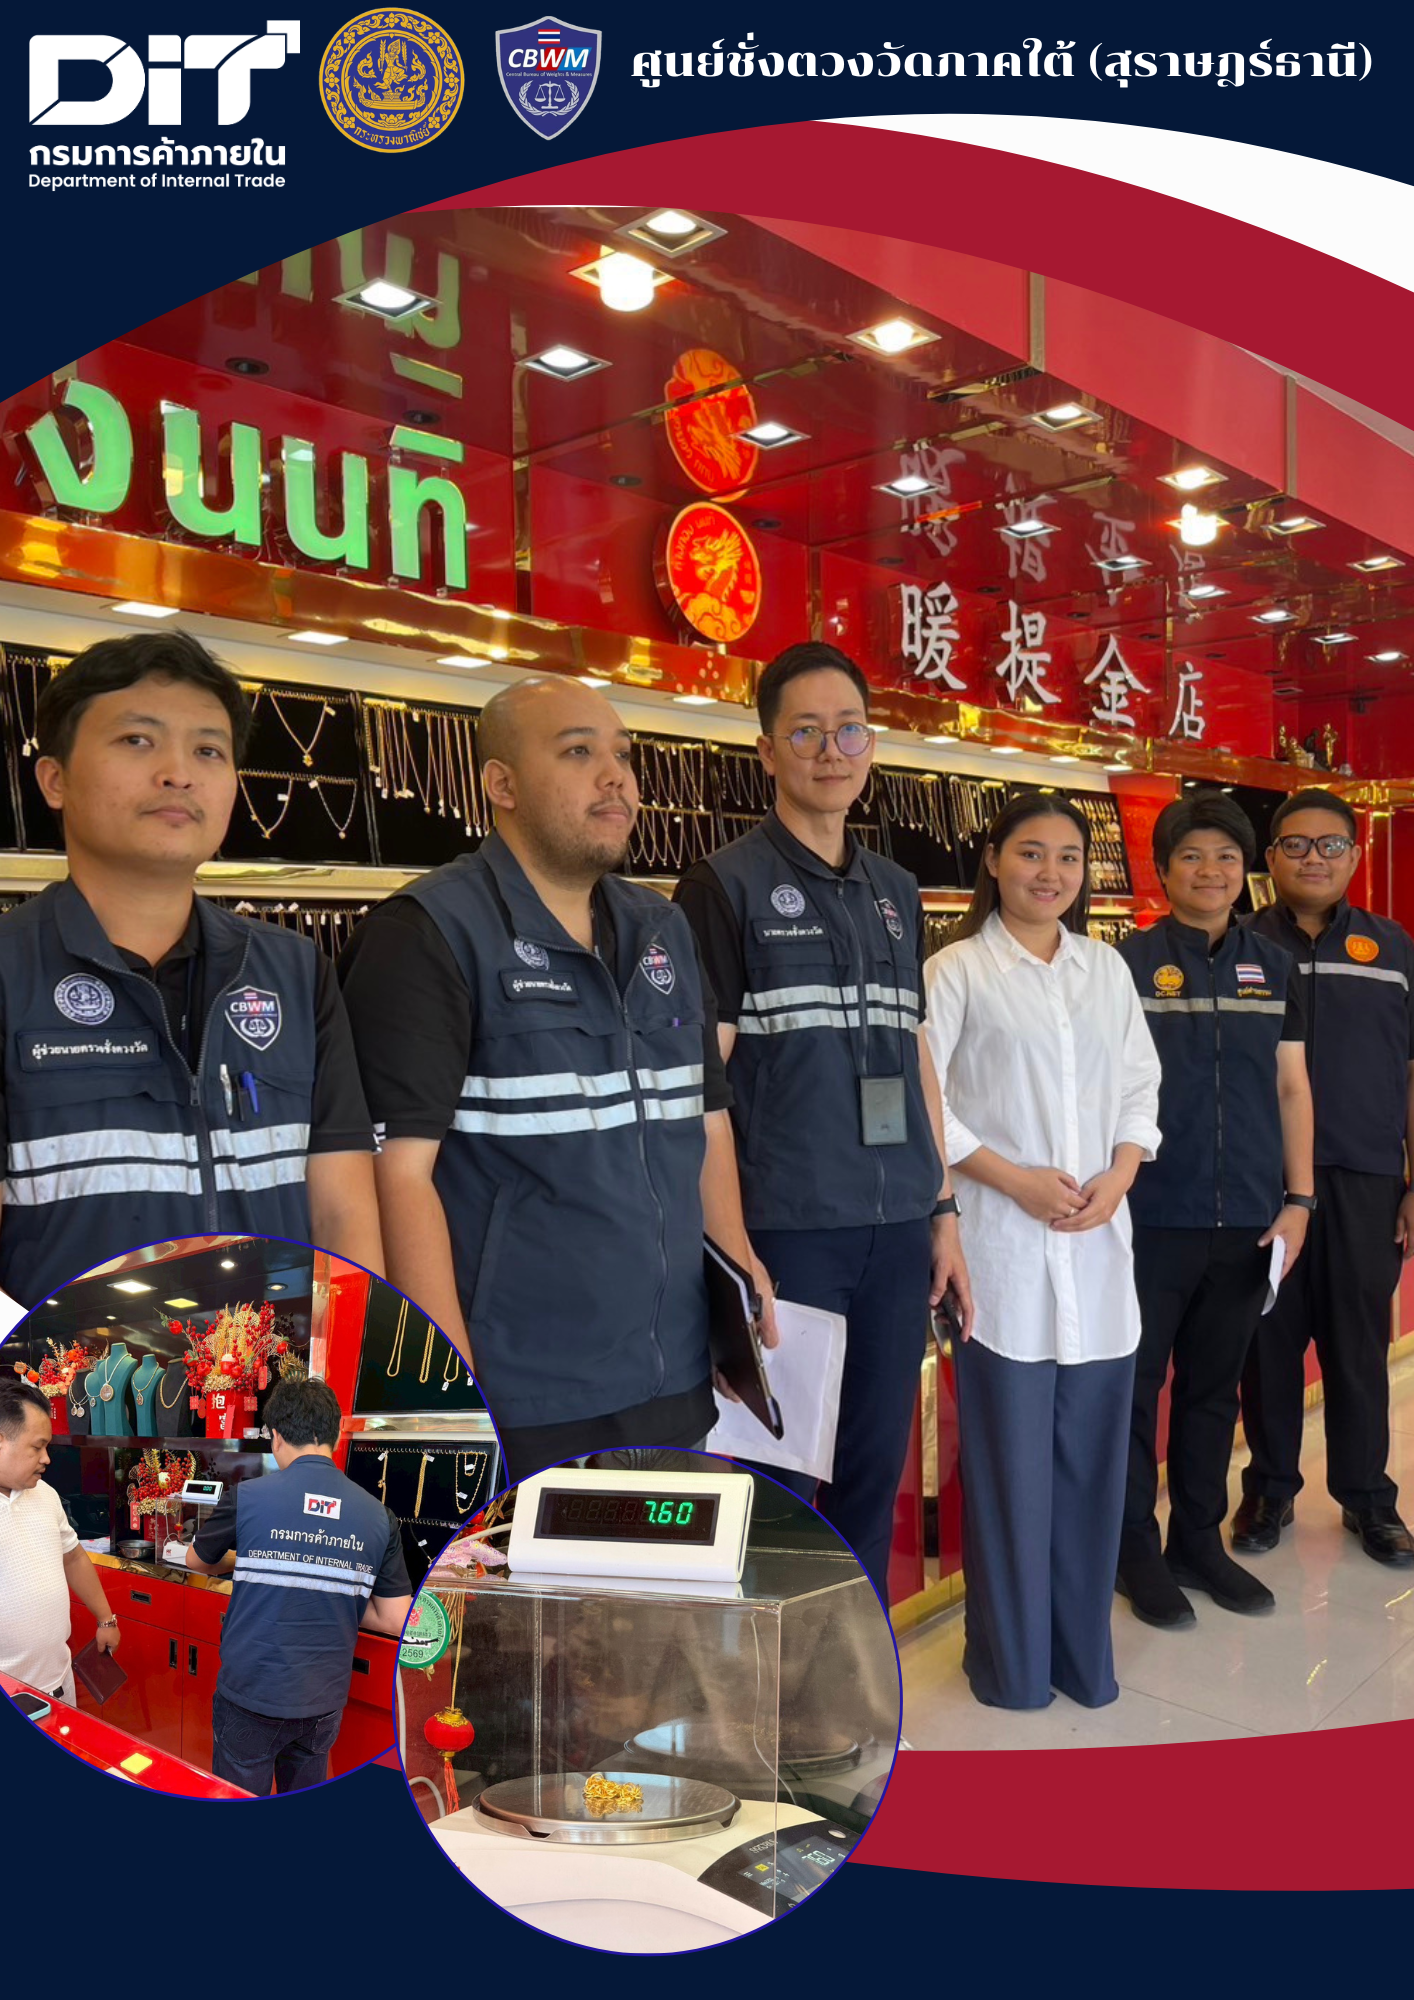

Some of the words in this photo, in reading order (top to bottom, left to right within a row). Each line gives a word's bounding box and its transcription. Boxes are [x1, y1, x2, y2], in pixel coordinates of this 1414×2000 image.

[900, 580, 1206, 741] 暖提金店
[230, 1000, 275, 1013] CBWM
[645, 1500, 694, 1525] 7.60
[270, 1527, 364, 1552] กรมการค้าภายใน
[248, 1549, 301, 1562] DEPARTMENT
[302, 1554, 314, 1564] OF
[315, 1556, 353, 1570] INTERNAL
[355, 1562, 374, 1574] TRADE
[402, 1648, 424, 1659] 2569
